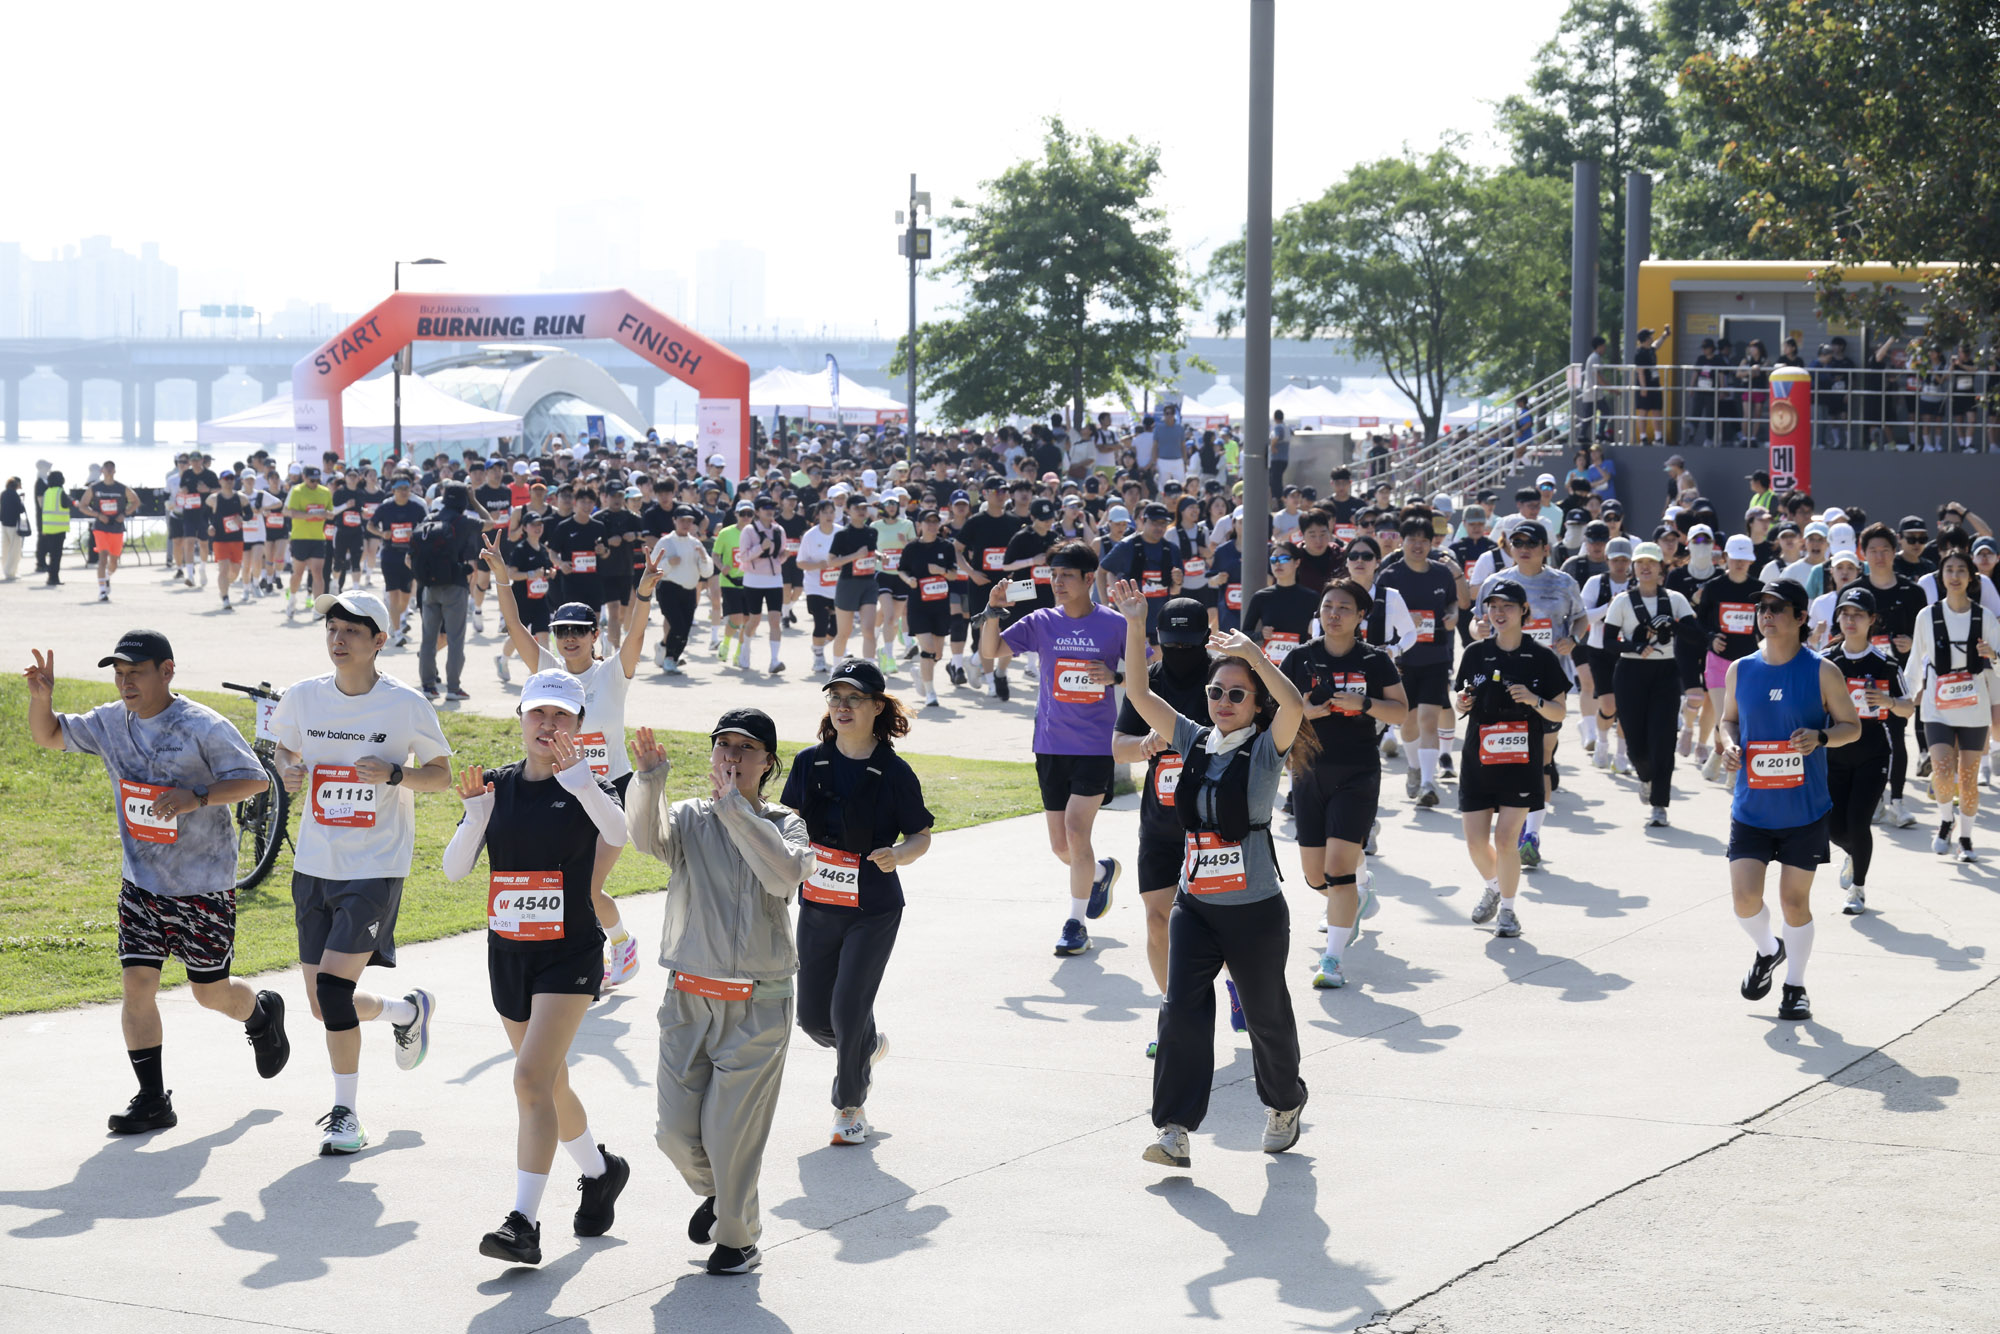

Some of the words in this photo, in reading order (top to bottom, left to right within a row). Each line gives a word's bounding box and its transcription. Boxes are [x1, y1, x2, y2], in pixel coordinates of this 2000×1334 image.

[417, 317, 524, 336] BURNING
[533, 315, 585, 335] RUN
[314, 316, 382, 375] START
[617, 313, 702, 375] FINISH
[1056, 637, 1095, 646] OSAKA
[1532, 632, 1550, 640] 722
[307, 729, 326, 738] new
[327, 730, 365, 741] balance
[1488, 738, 1495, 746] W
[1498, 736, 1526, 745] 4559
[1757, 760, 1764, 768] M
[1768, 757, 1800, 768] 2010
[322, 790, 331, 798] M
[336, 788, 373, 801] 1113
[128, 804, 136, 813] M
[329, 807, 351, 815] C-127
[1200, 853, 1240, 866] 4493
[819, 868, 856, 884] 4462
[499, 900, 510, 909] W
[513, 896, 561, 910] 4540
[493, 920, 512, 928] A-261
